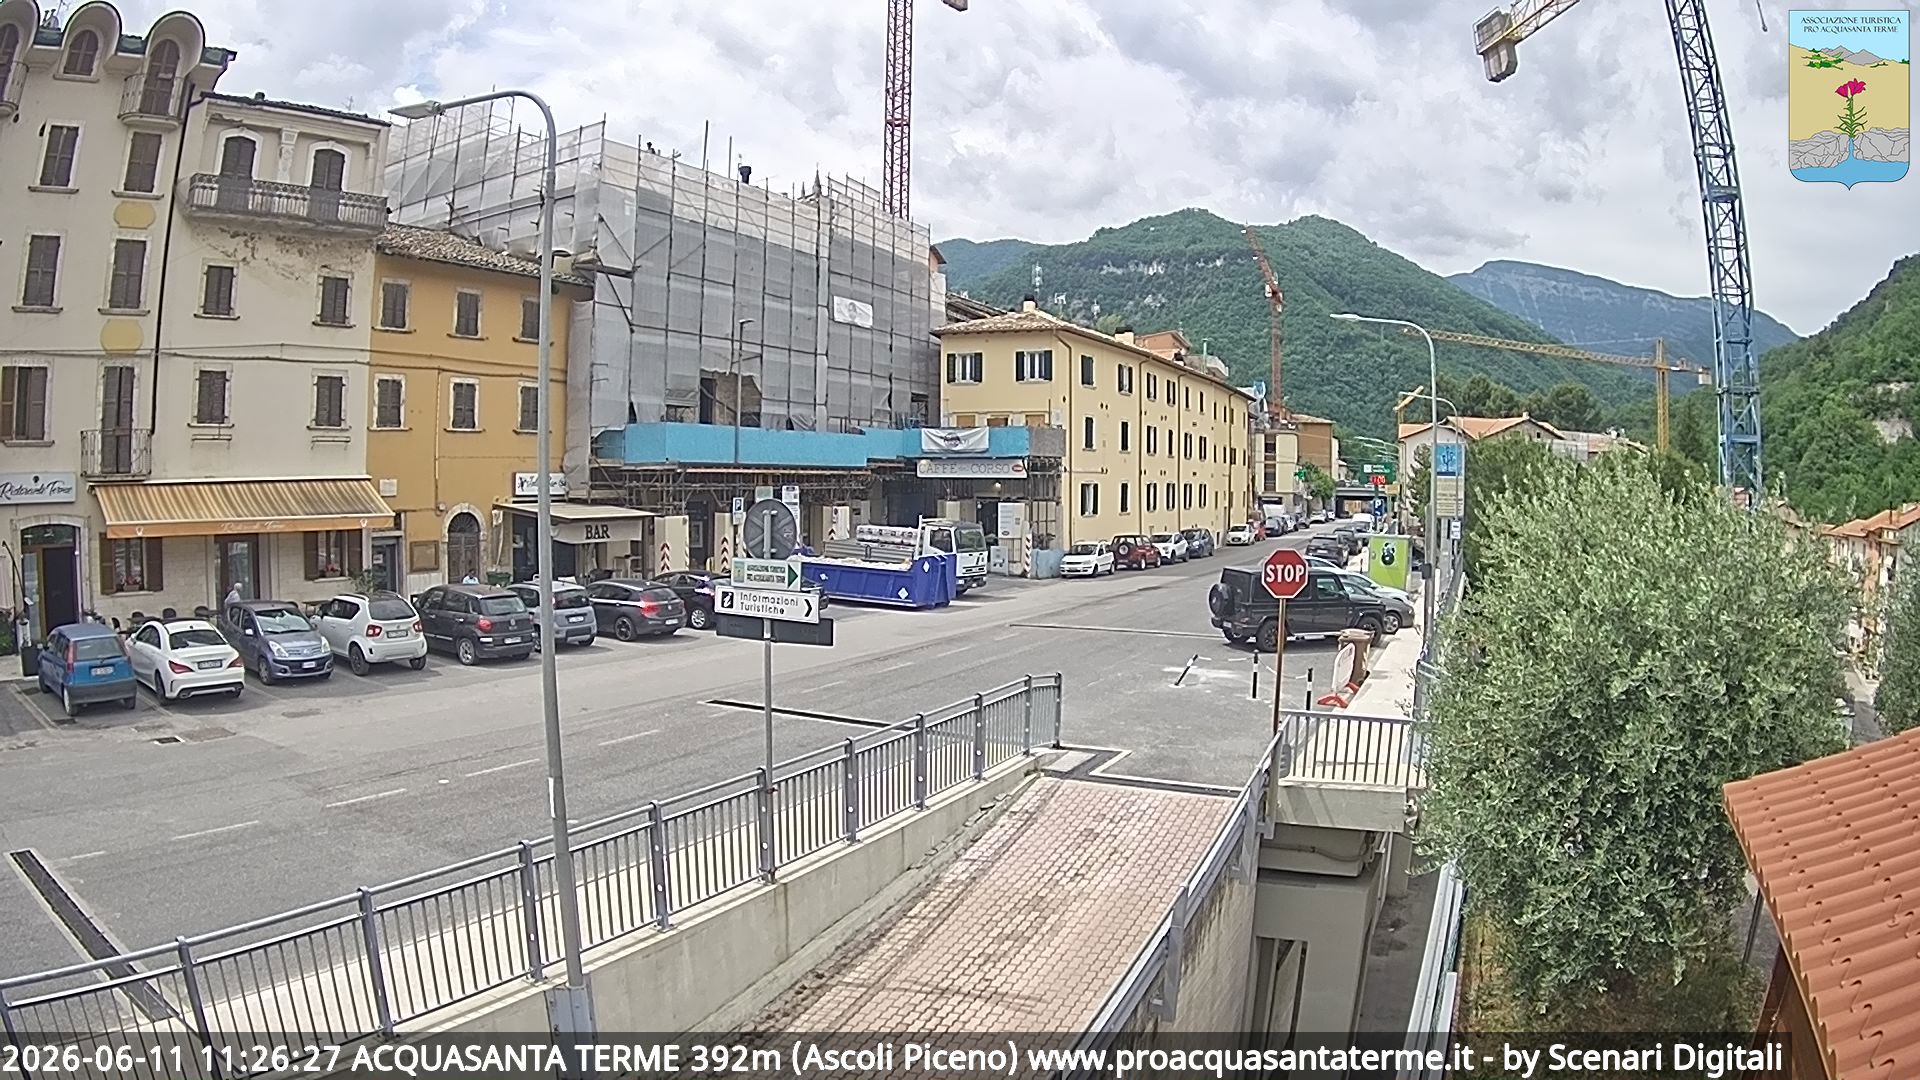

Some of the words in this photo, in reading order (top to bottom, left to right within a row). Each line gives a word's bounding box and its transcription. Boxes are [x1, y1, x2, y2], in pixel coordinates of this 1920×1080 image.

[970, 463, 1011, 474] CORSO
[585, 524, 610, 540] BAR
[1265, 564, 1305, 583] STOP
[740, 592, 798, 606] Informazioni
[740, 601, 785, 615] Turistiche
